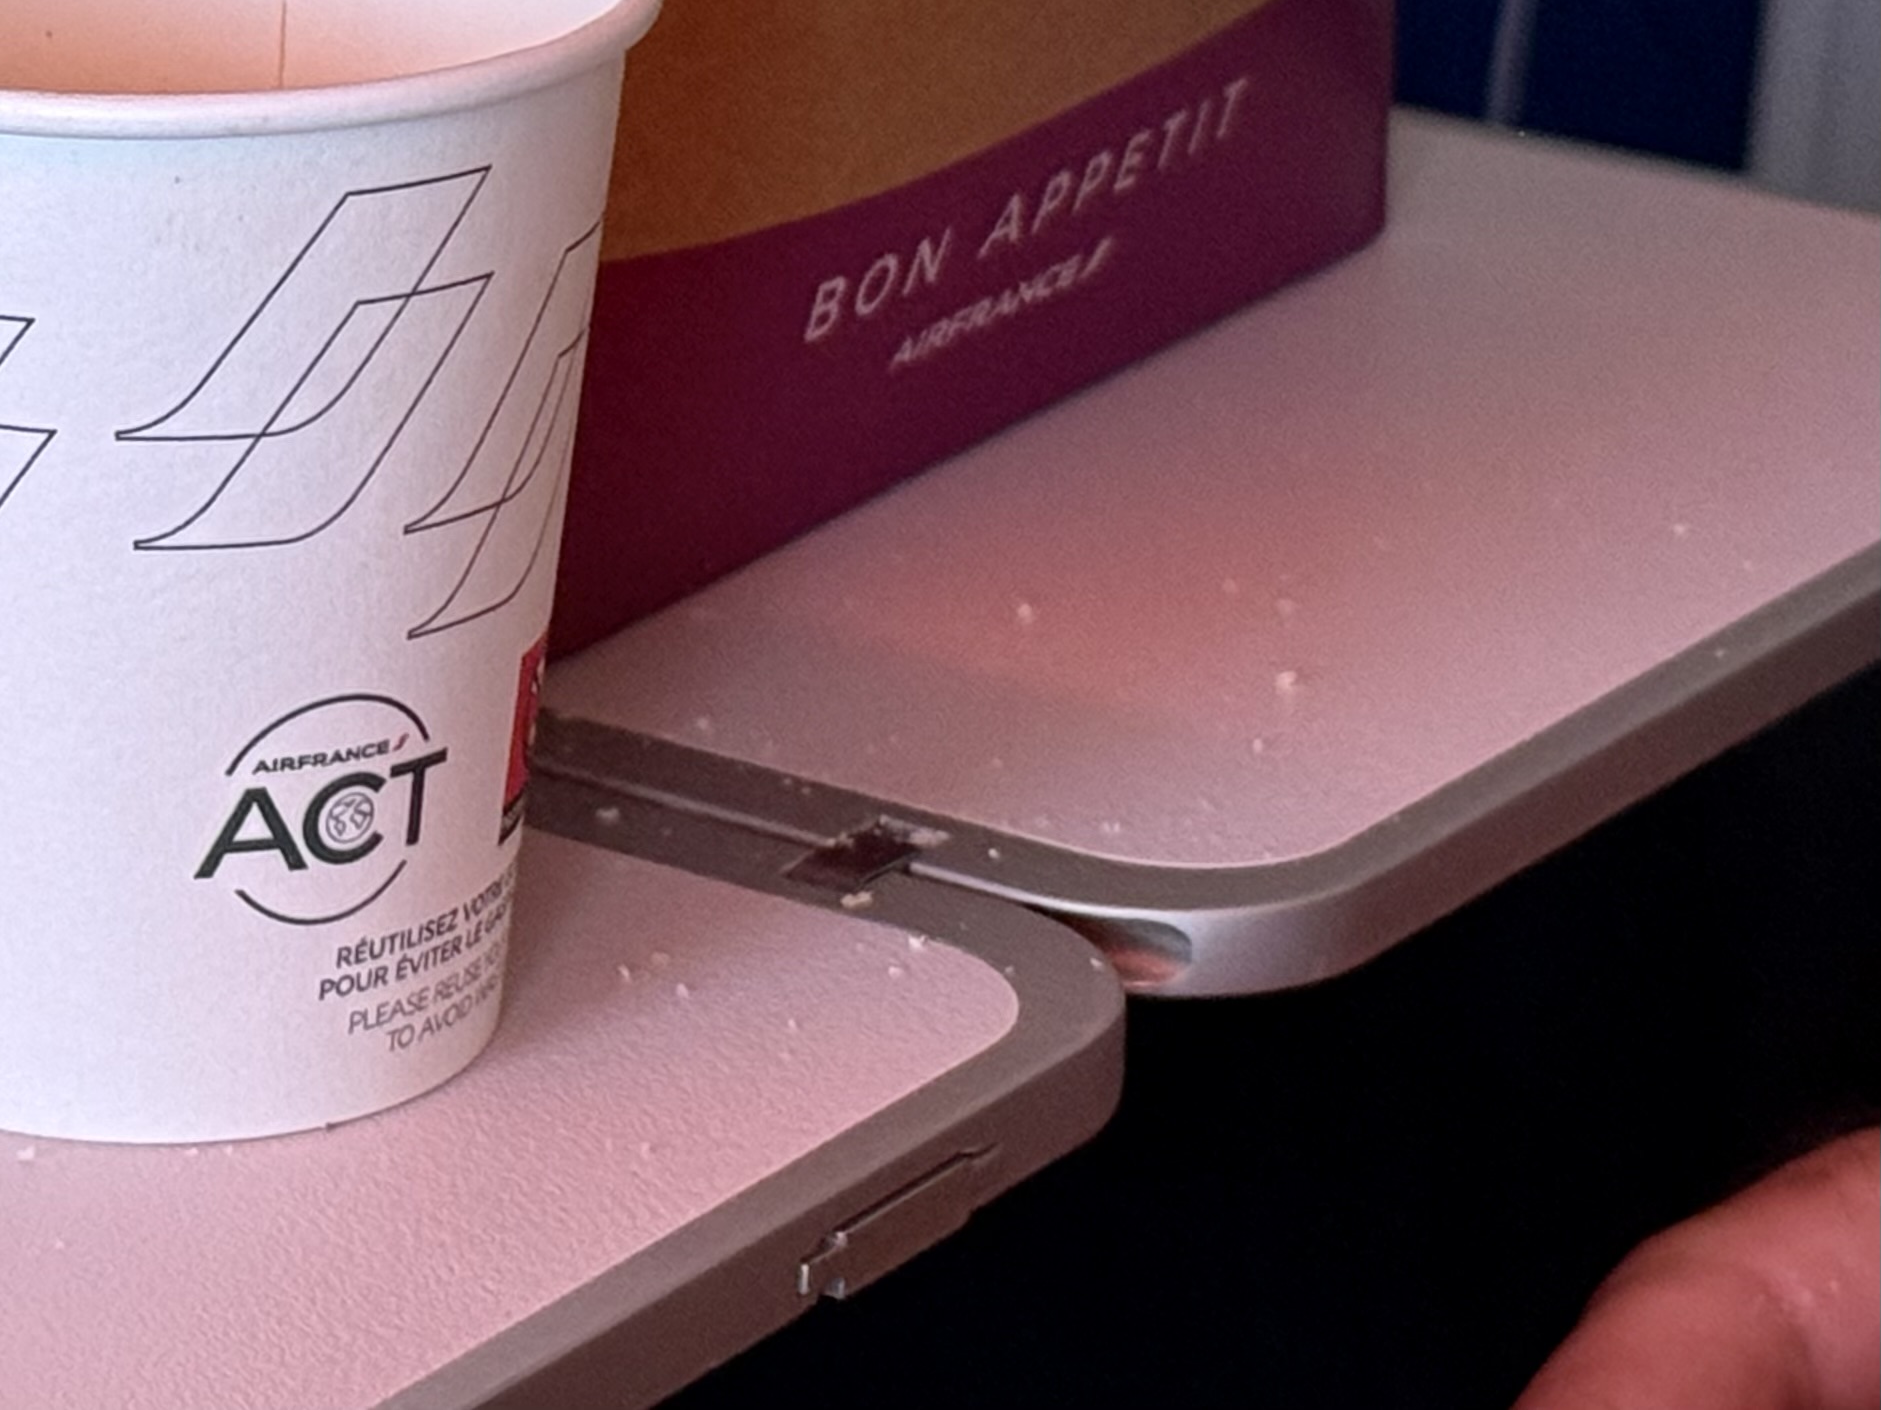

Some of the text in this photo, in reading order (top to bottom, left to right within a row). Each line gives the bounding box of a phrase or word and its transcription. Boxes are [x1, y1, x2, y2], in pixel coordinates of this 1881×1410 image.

[804, 77, 1249, 345] BON APPETIT
[252, 739, 390, 775] AIRFRANCE
[193, 747, 448, 880] ACT
[319, 966, 388, 1002] POUR
[395, 932, 463, 981] ÉVITER
[336, 907, 458, 970] RÉUTILISEZ
[348, 986, 428, 1035] PLEASE
[387, 1022, 415, 1052] TO
